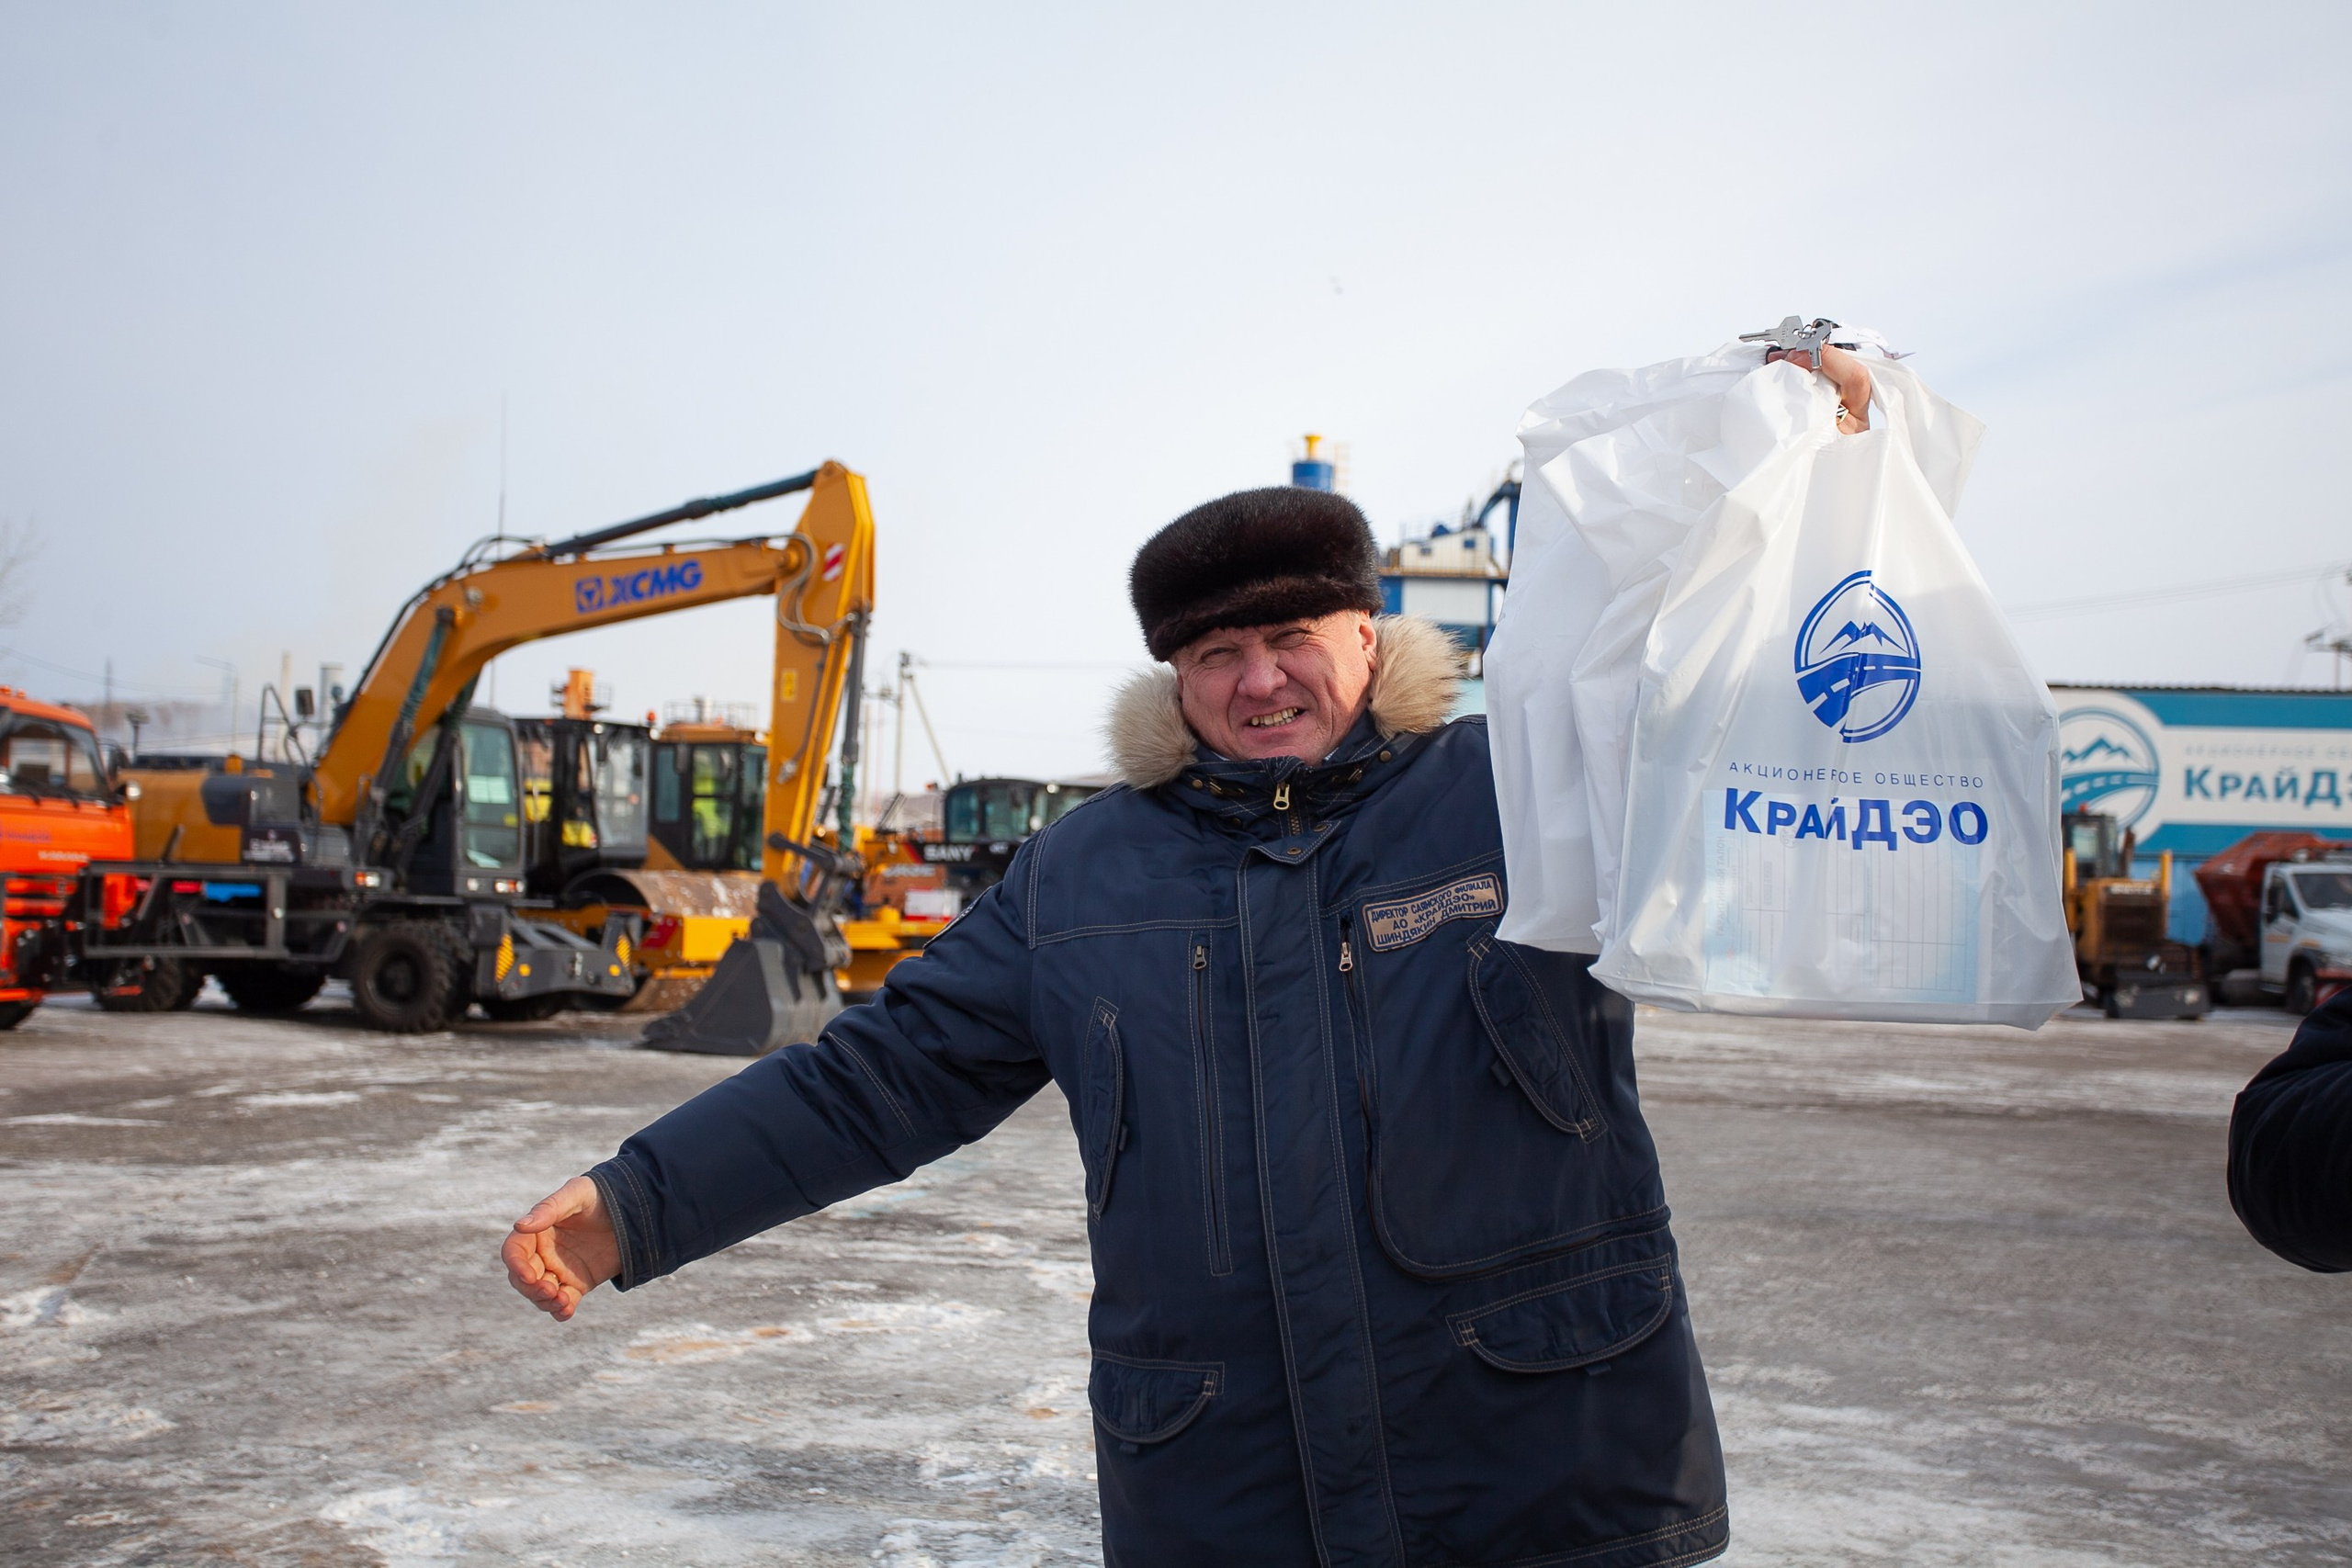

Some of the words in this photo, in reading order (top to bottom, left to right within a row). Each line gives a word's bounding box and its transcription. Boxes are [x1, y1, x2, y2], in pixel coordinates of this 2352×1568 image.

[609, 558, 702, 607] XCMG
[1874, 772, 1984, 789] ОБЩЕСТВО
[2184, 764, 2352, 808] КРАЙД
[924, 844, 975, 862] SANY
[1372, 908, 1408, 923] ДИРЕКТОР
[1411, 890, 1452, 914] САЯНСКОГО
[1454, 880, 1492, 894] ФИЛИАЛА
[1376, 917, 1436, 945] ШИНДЯКИН
[1441, 899, 1497, 919] ДМИТРИЙ
[1393, 919, 1408, 931] АО
